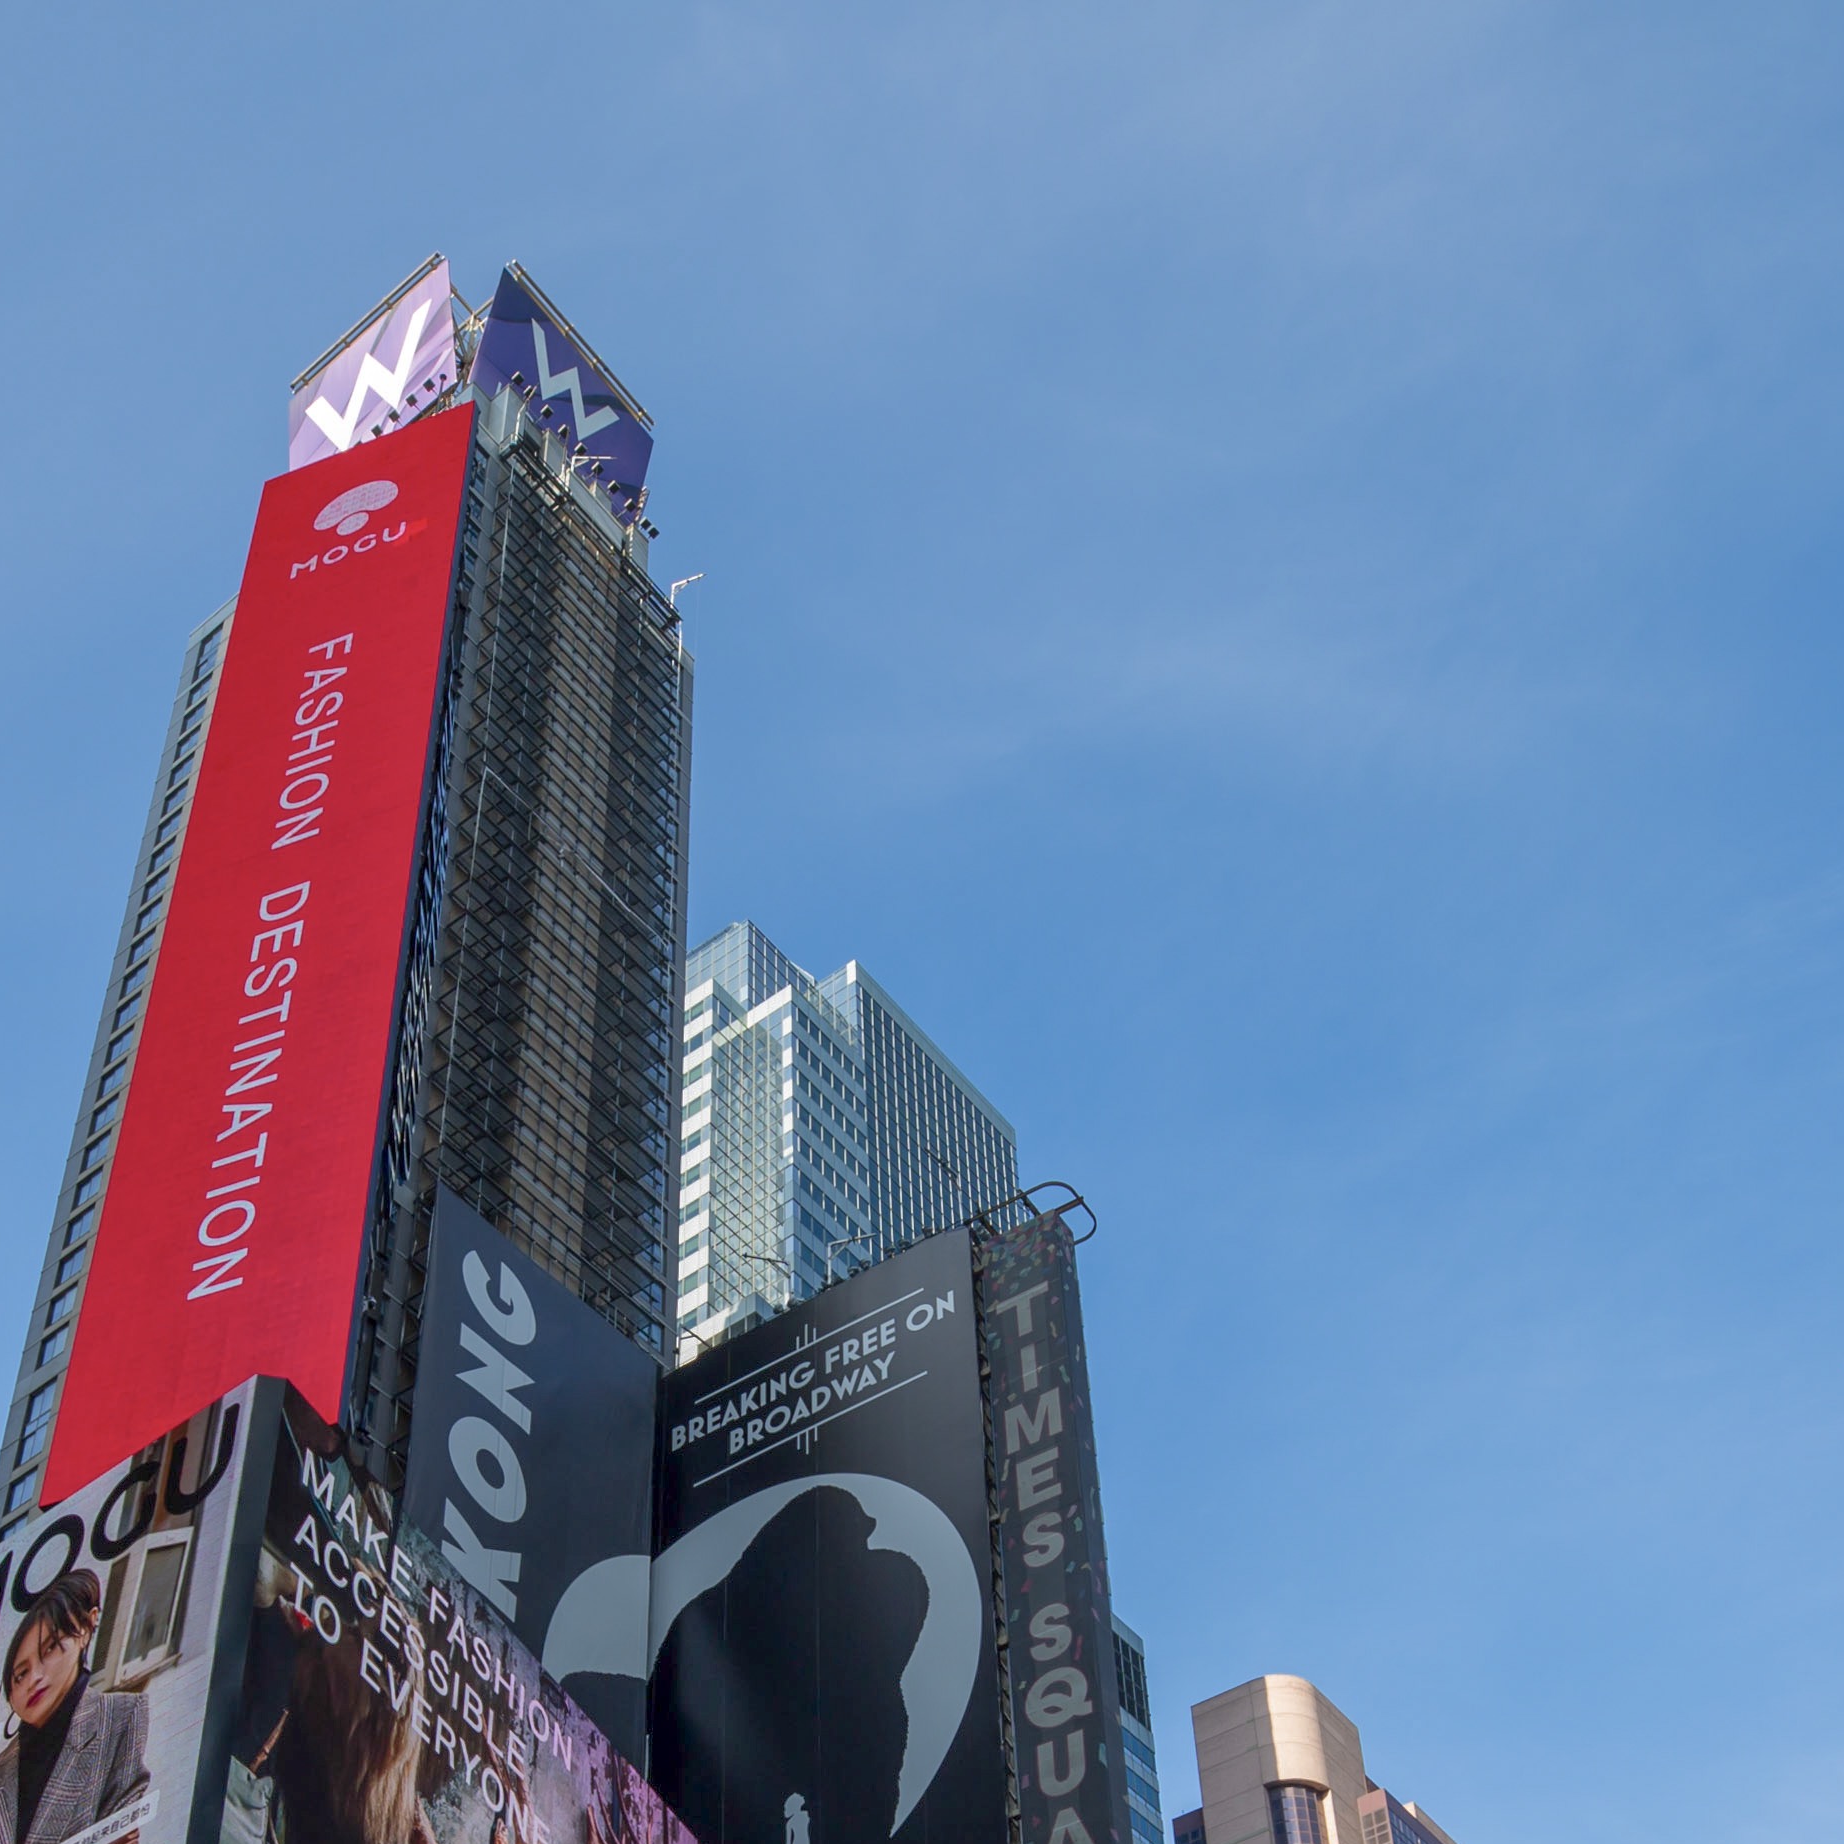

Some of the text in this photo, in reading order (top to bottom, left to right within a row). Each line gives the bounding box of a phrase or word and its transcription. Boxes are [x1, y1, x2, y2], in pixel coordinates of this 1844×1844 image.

[305, 298, 432, 452] W
[531, 317, 620, 441] W
[290, 520, 407, 581] MOGU
[188, 633, 352, 1302] FASHION DESTINATION
[671, 1289, 955, 1452] BREAKING FREE ON
[730, 1353, 895, 1454] BROADWAY
[995, 1281, 1063, 1570] TIMES
[290, 1562, 342, 1644] TO
[296, 1515, 527, 1778] ACCESSIBLE
[302, 1448, 574, 1773] MAKE FASHION
